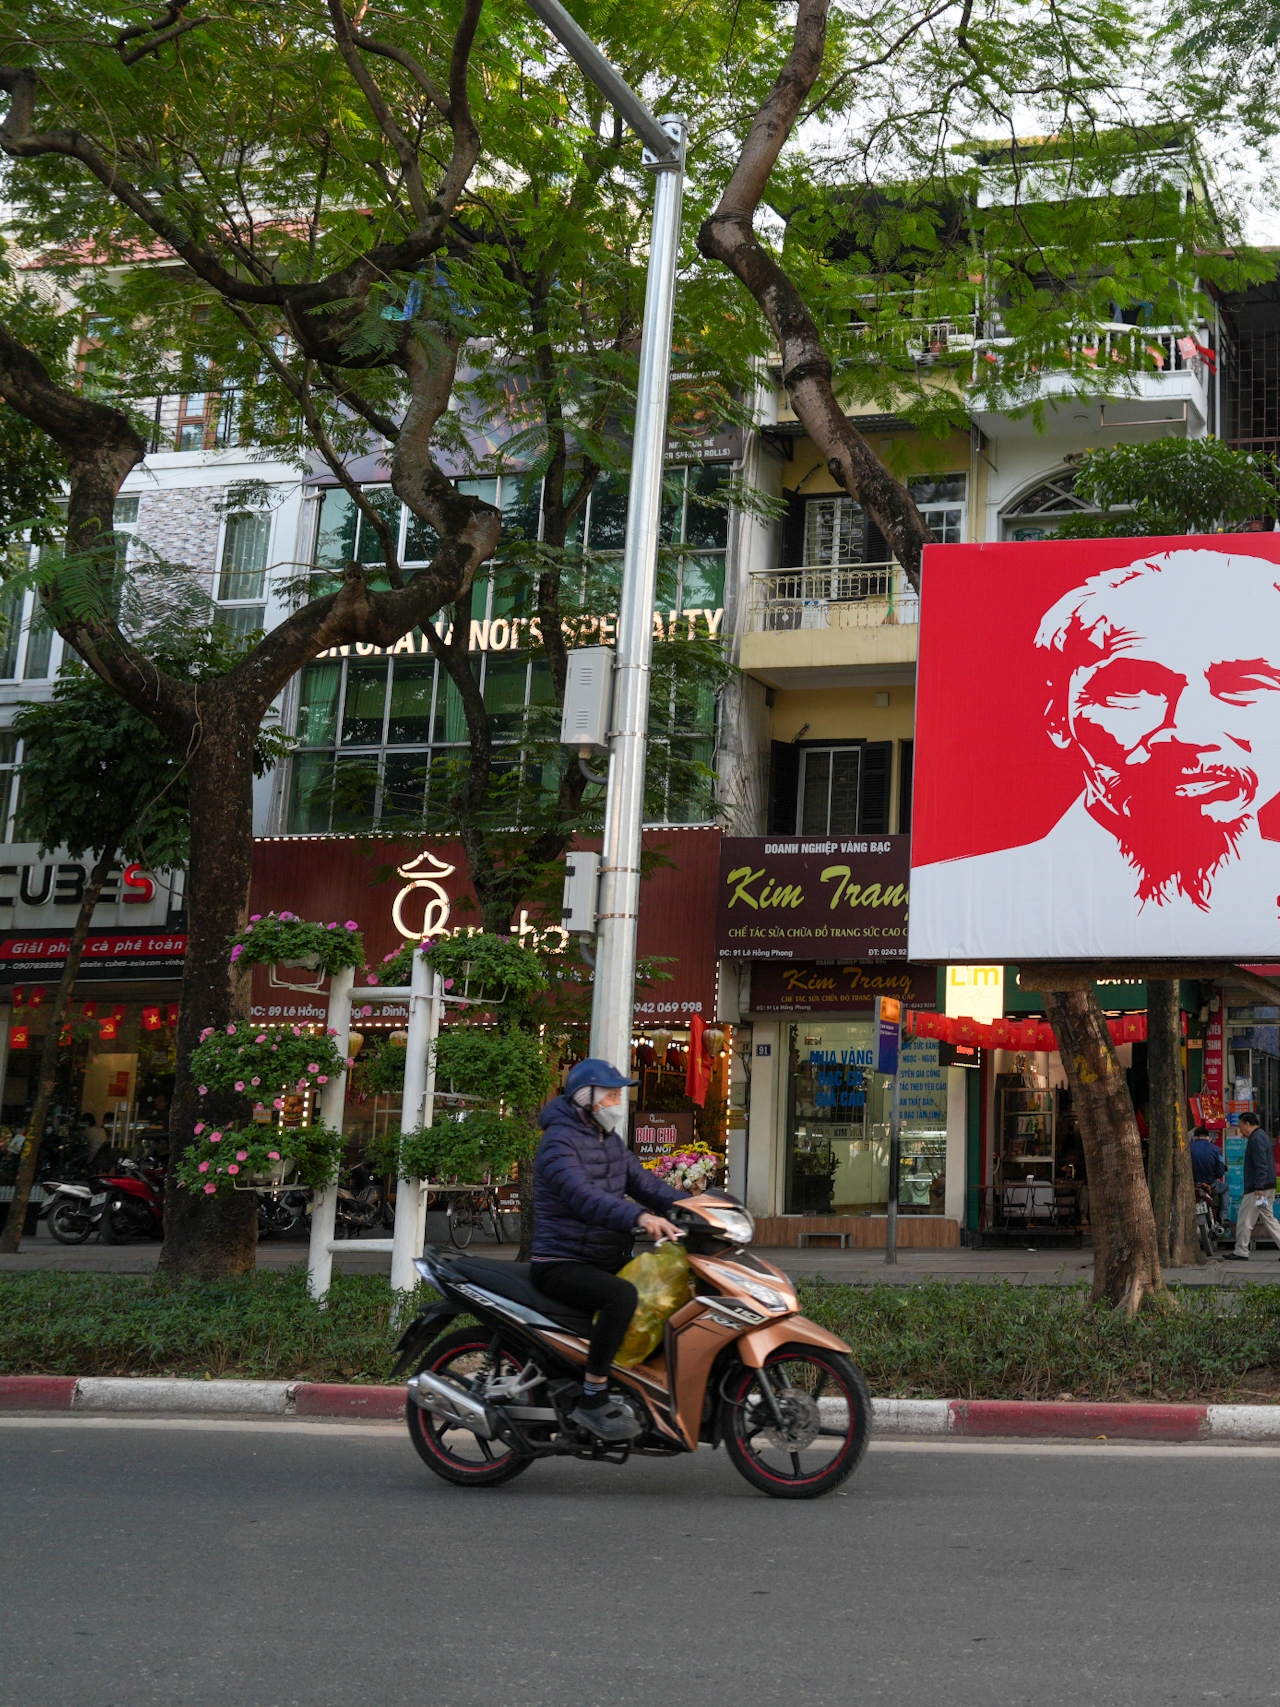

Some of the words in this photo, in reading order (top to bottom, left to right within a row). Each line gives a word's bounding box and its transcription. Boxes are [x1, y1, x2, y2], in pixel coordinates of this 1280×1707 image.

[704, 448, 730, 456] ROLLS)
[765, 843, 798, 854] DOANH
[801, 840, 838, 855] NGHIỆP
[840, 840, 867, 853] VÀNG
[870, 841, 891, 854] BẠC
[726, 866, 804, 911] Kim
[728, 925, 747, 938] CHẾ
[749, 926, 766, 937] TÁC
[768, 926, 785, 938] SỬA
[787, 926, 812, 937] CHỮA
[815, 924, 828, 937] ĐỒ
[830, 928, 860, 938] TRANG
[863, 926, 880, 937] SỨC
[882, 927, 900, 937] CAO
[12, 941, 43, 954] Giải
[91, 941, 109, 951] cà
[114, 939, 143, 953] phê
[148, 938, 183, 950] toàn
[733, 949, 741, 957] 91
[742, 949, 751, 957] Lê
[752, 947, 770, 957] Hồng
[771, 949, 793, 957] Phong
[783, 969, 837, 990] Kim
[843, 967, 914, 994] Trang
[268, 1006, 281, 1017] 89
[283, 1005, 296, 1017] Lê
[297, 1003, 326, 1019] Hồng
[382, 1004, 408, 1018] Đình,
[633, 1002, 655, 1013] 942
[657, 1002, 680, 1013] 069
[681, 1001, 702, 1013] 998
[758, 1045, 769, 1055] 91
[810, 1050, 837, 1065] MUA
[841, 1046, 873, 1065] VÀNG
[840, 1091, 866, 1107] CAO
[657, 1124, 677, 1143] CHẢ
[640, 1144, 653, 1153] HÀ
[734, 1307, 761, 1321] 110
[631, 1366, 664, 1385] HONDA
